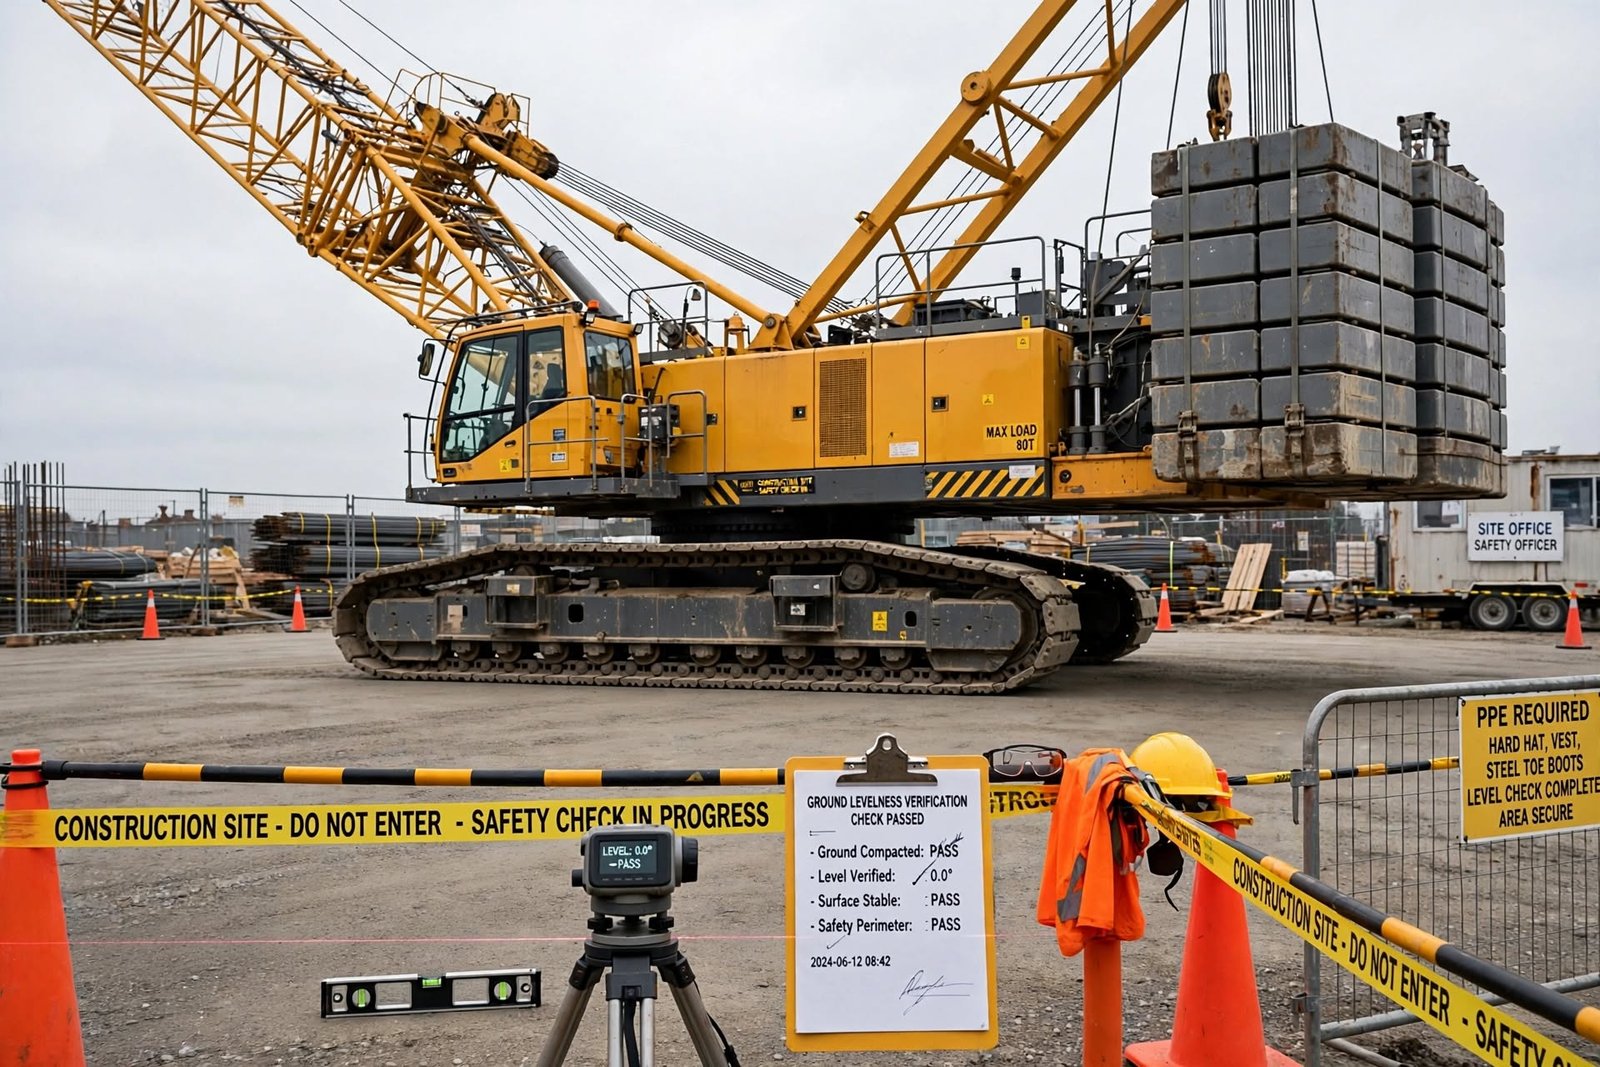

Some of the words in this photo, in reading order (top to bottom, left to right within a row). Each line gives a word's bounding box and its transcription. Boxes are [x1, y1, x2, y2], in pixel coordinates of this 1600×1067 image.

[986, 426, 1008, 438] MAX
[1010, 424, 1037, 438] LOAD
[1016, 438, 1035, 451] 80T
[1478, 522, 1505, 536] SITE
[1508, 521, 1553, 536] OFFICE
[1474, 539, 1512, 551] SAFETY
[1514, 538, 1558, 551] OFFICER
[1477, 705, 1508, 728] PPE
[1513, 700, 1590, 726] REQUIRED
[1489, 735, 1521, 754] HARD
[1523, 733, 1548, 753] HAT,
[1550, 731, 1581, 750] VEST,
[1486, 759, 1521, 780] STEEL
[1523, 757, 1545, 776] TOE
[1547, 753, 1584, 774] BOOTS
[1467, 786, 1503, 807] LEVEL
[1505, 781, 1543, 803] CHECK
[1545, 776, 1600, 799] COMPLETE
[807, 795, 848, 809] GROUND
[849, 795, 903, 809] LEVELNESS
[904, 794, 968, 809] VERIFICATION
[54, 813, 217, 842] CONSTRUCTION
[223, 812, 269, 840] SITE
[290, 812, 320, 838] DO
[326, 811, 369, 838] NOT
[375, 810, 442, 837] ENTER
[471, 807, 550, 836] SAFETY
[556, 805, 626, 834] CHECK
[632, 805, 652, 825] IN
[660, 801, 769, 830] PROGRESS
[850, 812, 884, 826] CHECK
[886, 812, 925, 826] PASSED
[1498, 807, 1529, 828] AREA
[1531, 803, 1574, 825] SECURE
[602, 845, 633, 857] LEVEL:
[634, 844, 653, 856] 0.0°
[817, 844, 857, 859] Ground
[860, 844, 924, 861] Compacted:
[929, 844, 959, 858] PASS
[818, 869, 847, 883] Level
[849, 868, 896, 883] Verified:
[930, 868, 953, 882] 0.0°
[818, 893, 860, 908] Surface
[862, 892, 901, 907] Stable:
[930, 892, 961, 907] PASS
[818, 918, 854, 936] Safety
[856, 917, 913, 932] Perimeter:
[931, 917, 961, 932] PASS
[810, 955, 863, 968] 2024-06-12
[864, 955, 891, 967] 08:42
[1233, 857, 1311, 933] CONSTRUCTION
[1313, 909, 1339, 952] SITE
[1349, 931, 1367, 971] DO
[1370, 944, 1398, 991] NOT
[1400, 963, 1450, 1026] ENTER
[1475, 1009, 1546, 1067] SAFETY
